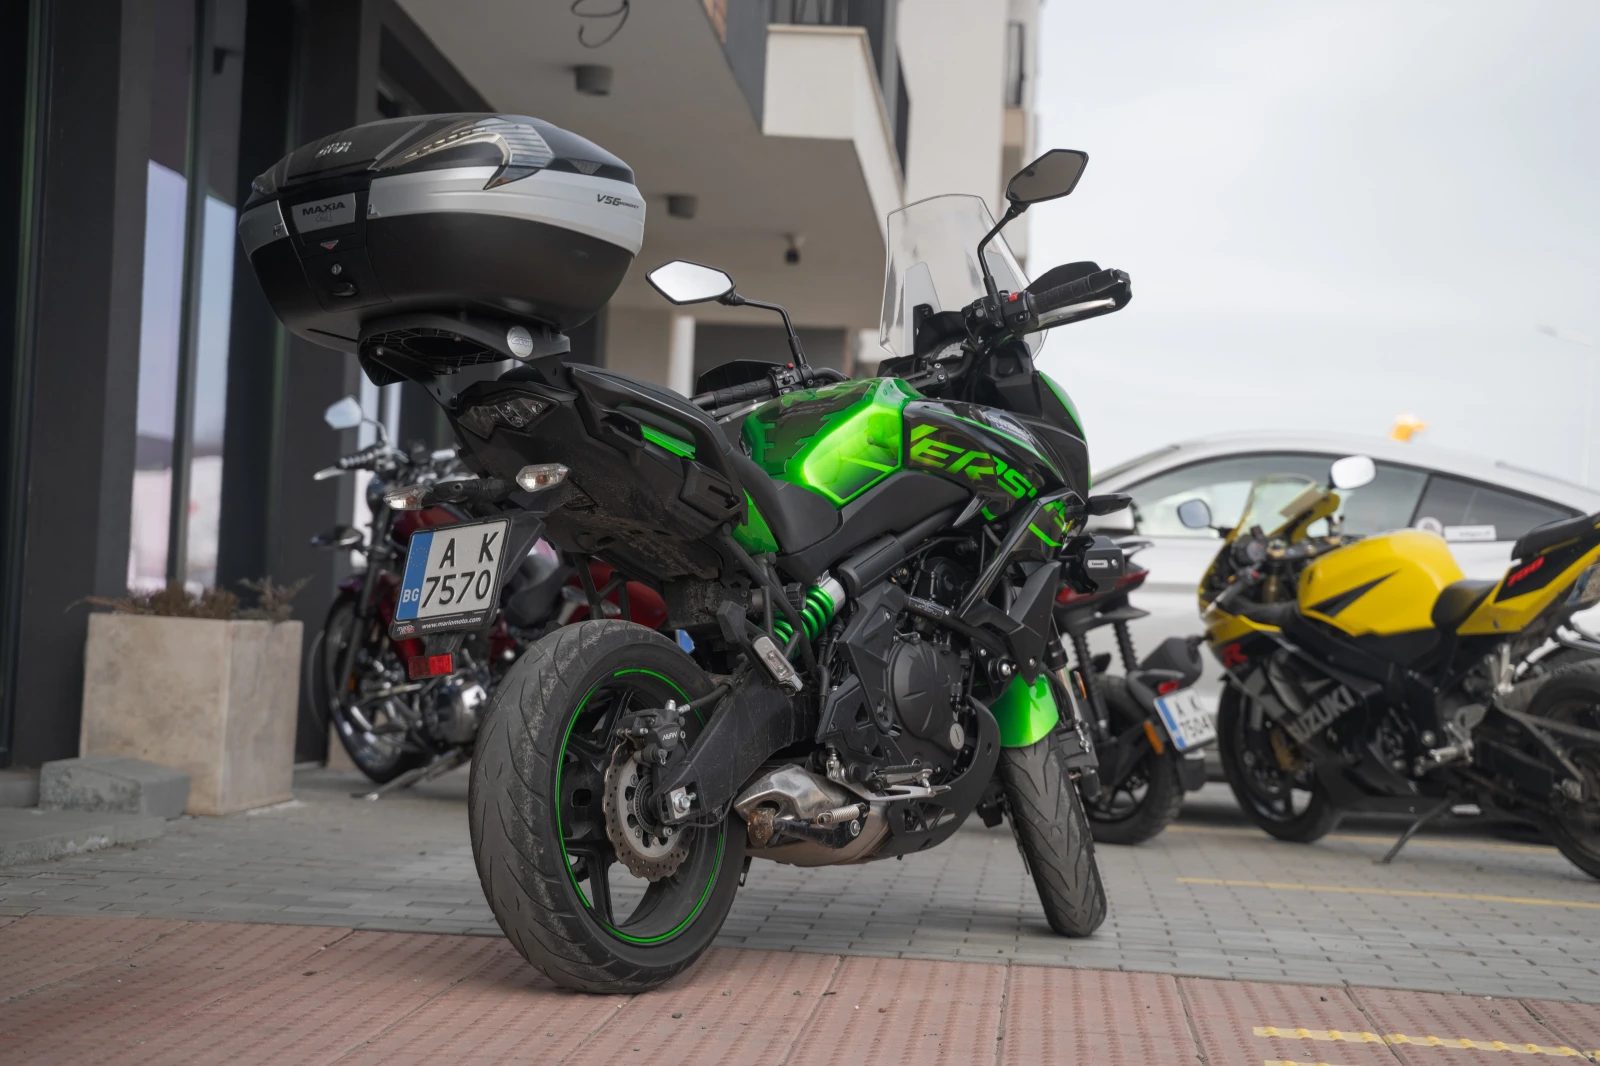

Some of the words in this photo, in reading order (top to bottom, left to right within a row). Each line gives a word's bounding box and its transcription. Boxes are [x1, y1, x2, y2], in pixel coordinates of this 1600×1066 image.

[597, 193, 622, 206] V56
[439, 537, 456, 569] A
[478, 531, 500, 564] K
[402, 588, 420, 603] BG
[421, 569, 492, 609] 7570
[422, 617, 481, 629] www.mariomoto.com
